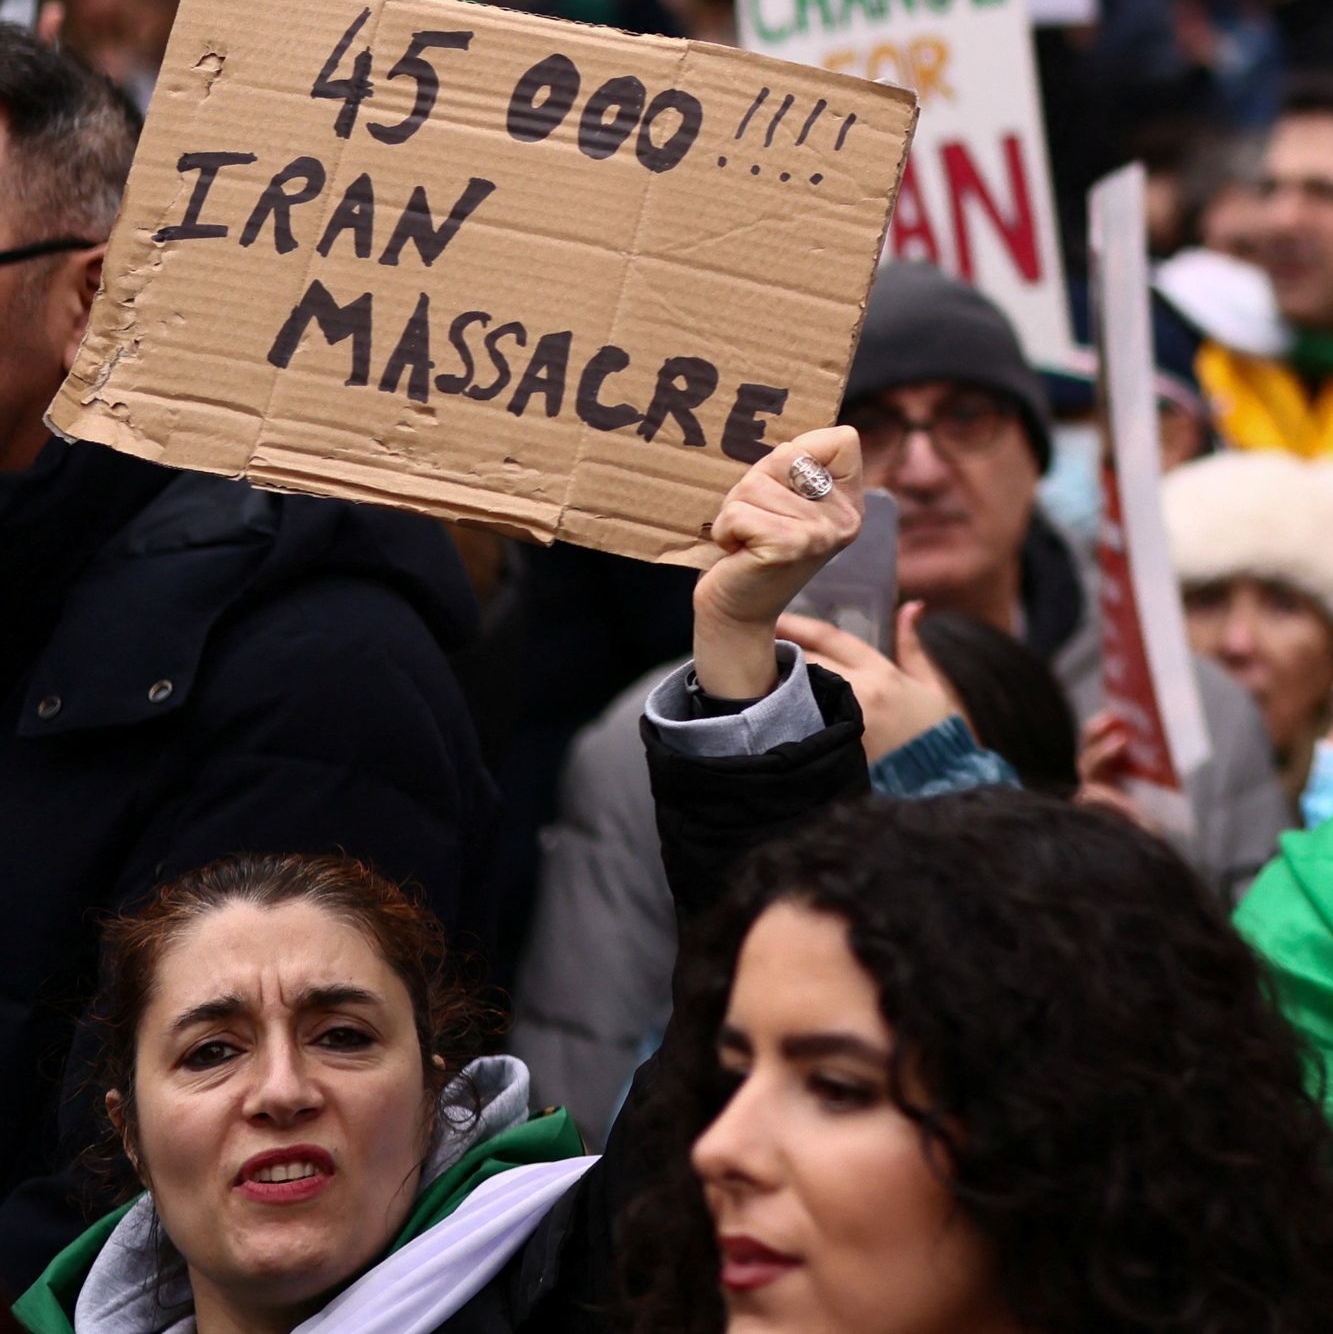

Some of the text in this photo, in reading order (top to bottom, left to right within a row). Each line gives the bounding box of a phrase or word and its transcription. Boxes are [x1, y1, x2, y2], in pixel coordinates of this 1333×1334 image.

[310, 6, 474, 146] 45
[152, 151, 496, 266] IRAN
[888, 133, 1043, 286] AN
[267, 279, 789, 466] MASSACRE
